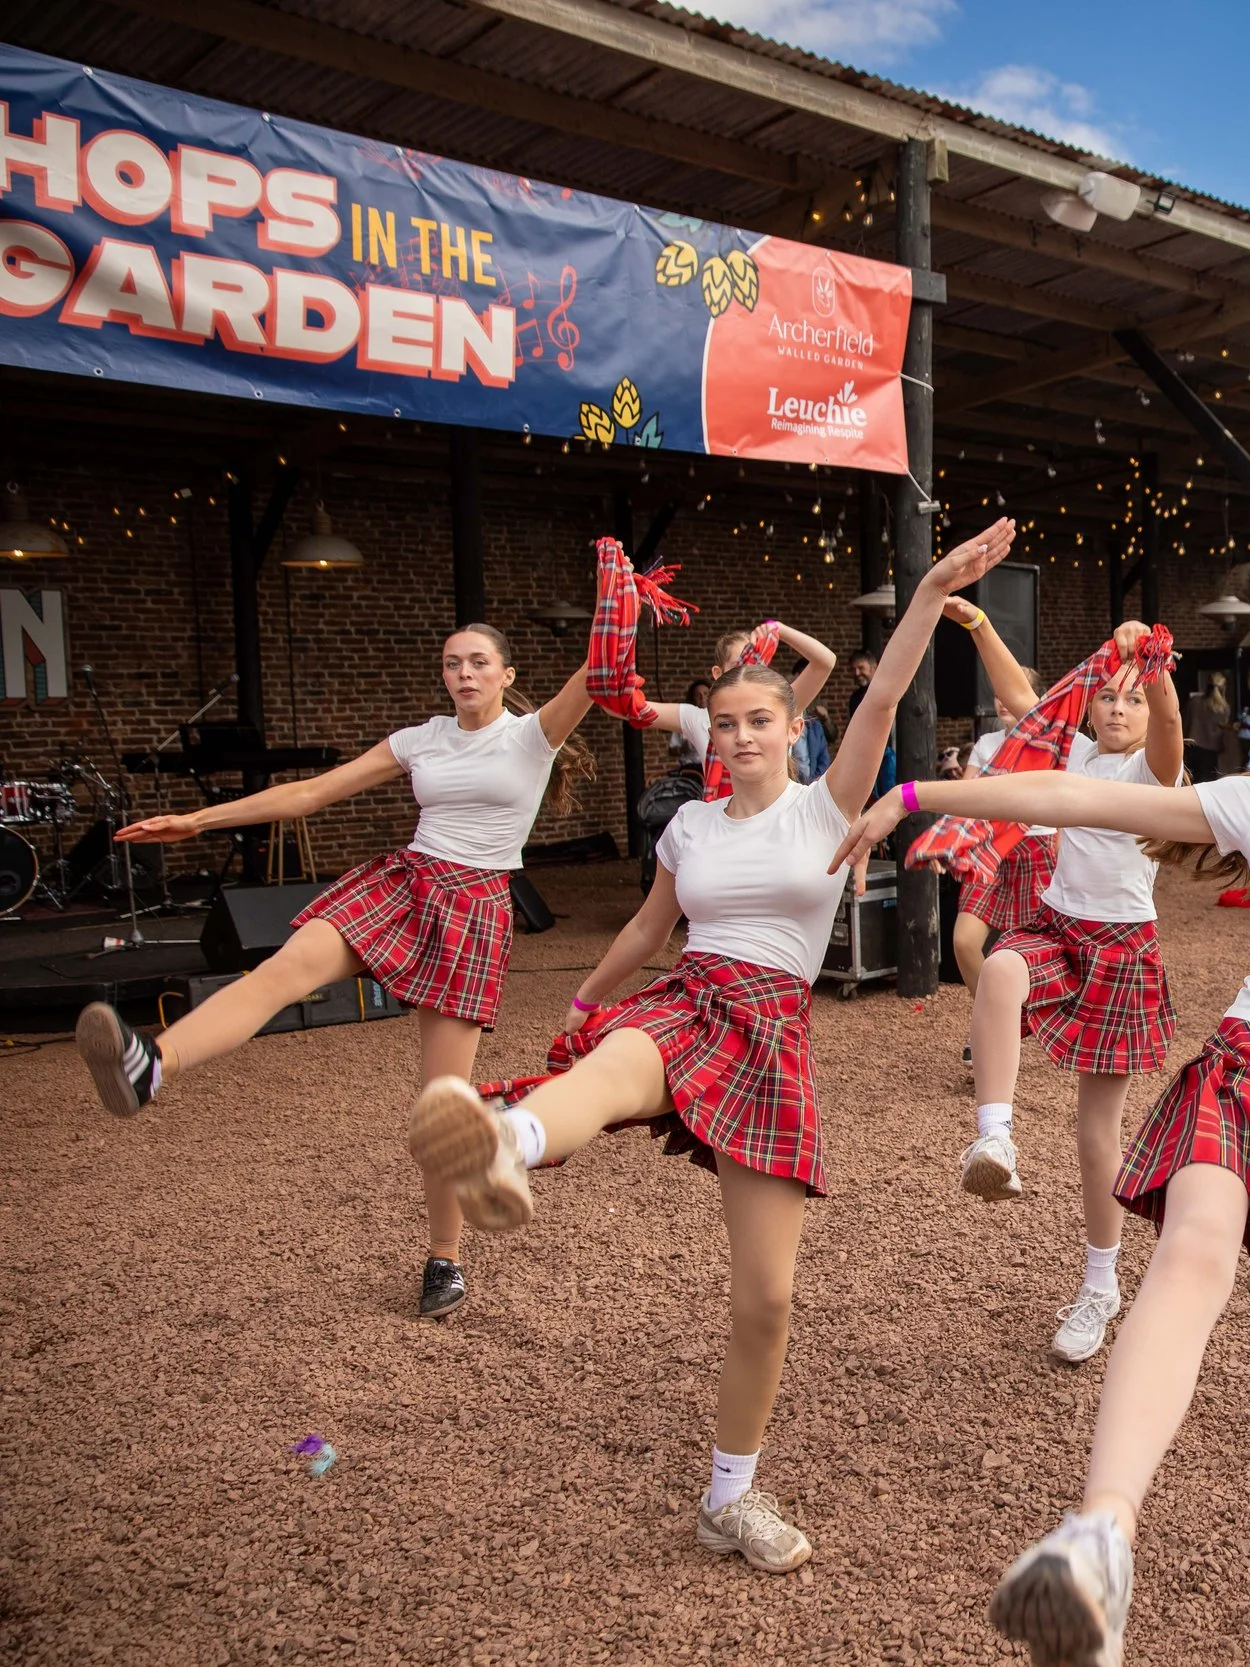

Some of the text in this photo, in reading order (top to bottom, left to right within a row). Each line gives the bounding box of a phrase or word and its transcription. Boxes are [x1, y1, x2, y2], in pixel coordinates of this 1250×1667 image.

[0, 101, 342, 258] HOPS
[351, 203, 497, 287] IN THE
[0, 219, 517, 389] GARDEN
[768, 313, 874, 357] Archerfield
[779, 346, 864, 370] WALLED GARDEN
[767, 385, 867, 427] Leuchie
[771, 418, 864, 440] Reimagining Respite
[0, 588, 69, 699] N
